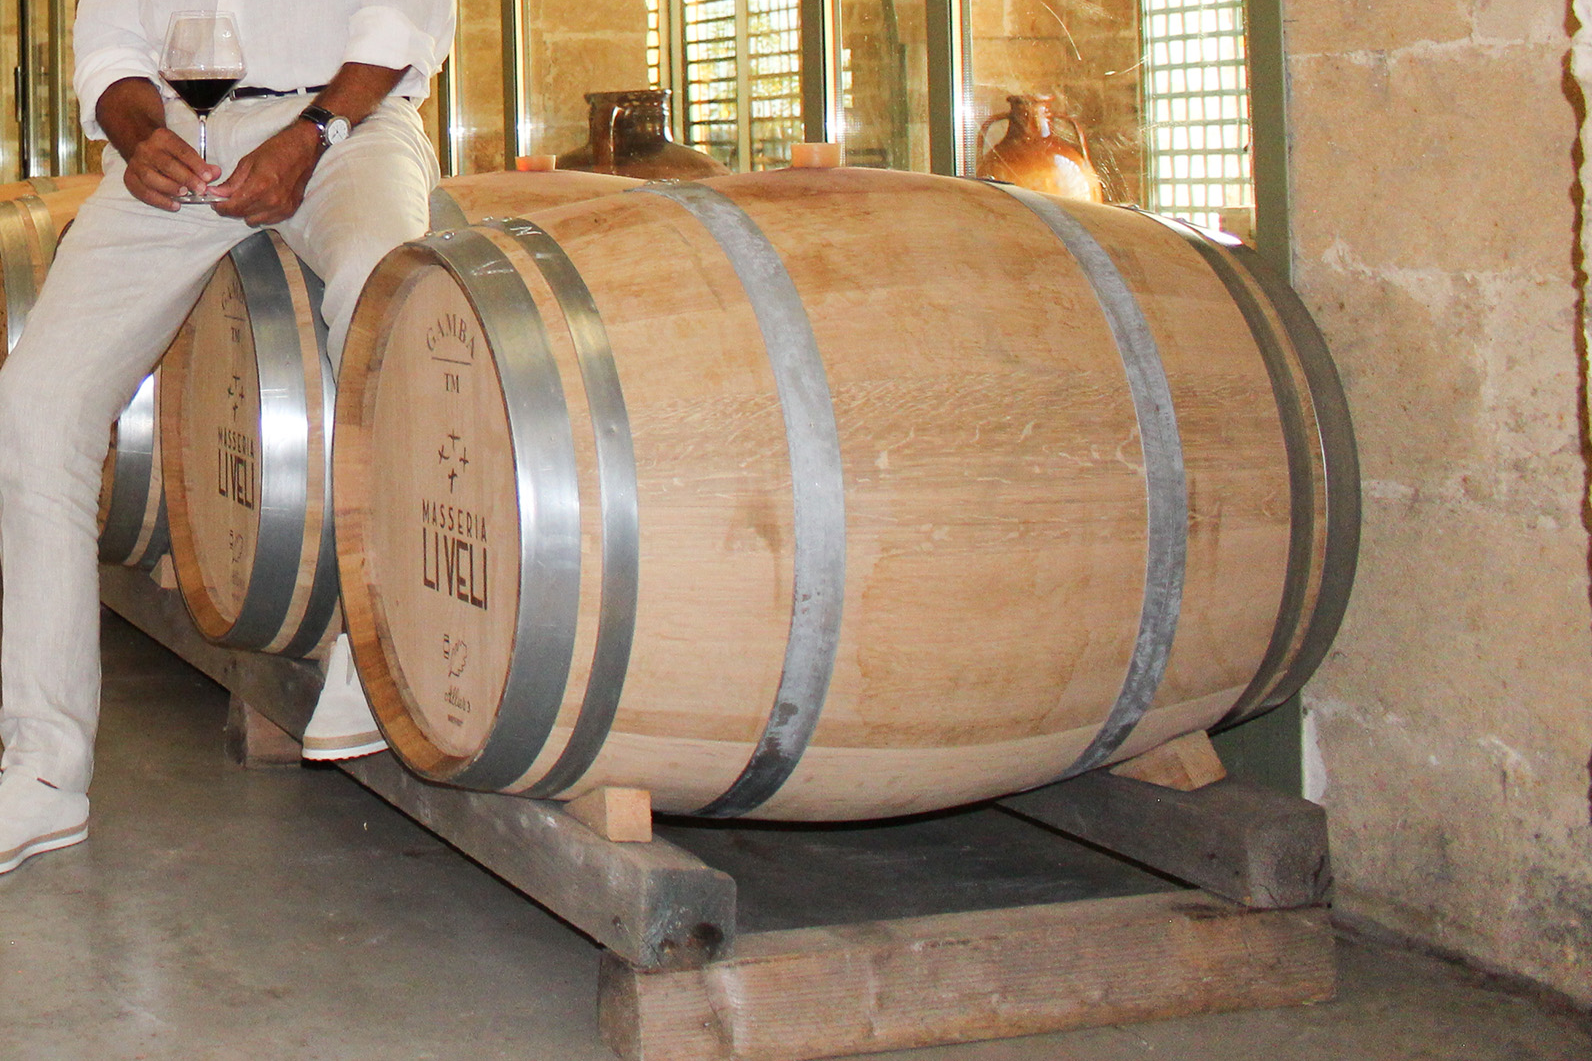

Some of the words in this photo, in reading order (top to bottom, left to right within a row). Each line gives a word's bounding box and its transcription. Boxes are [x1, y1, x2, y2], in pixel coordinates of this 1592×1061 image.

[426, 313, 475, 360] GAMBA
[444, 373, 460, 394] TM
[218, 426, 255, 459] MASSERIA
[422, 498, 487, 543] MASSERIA
